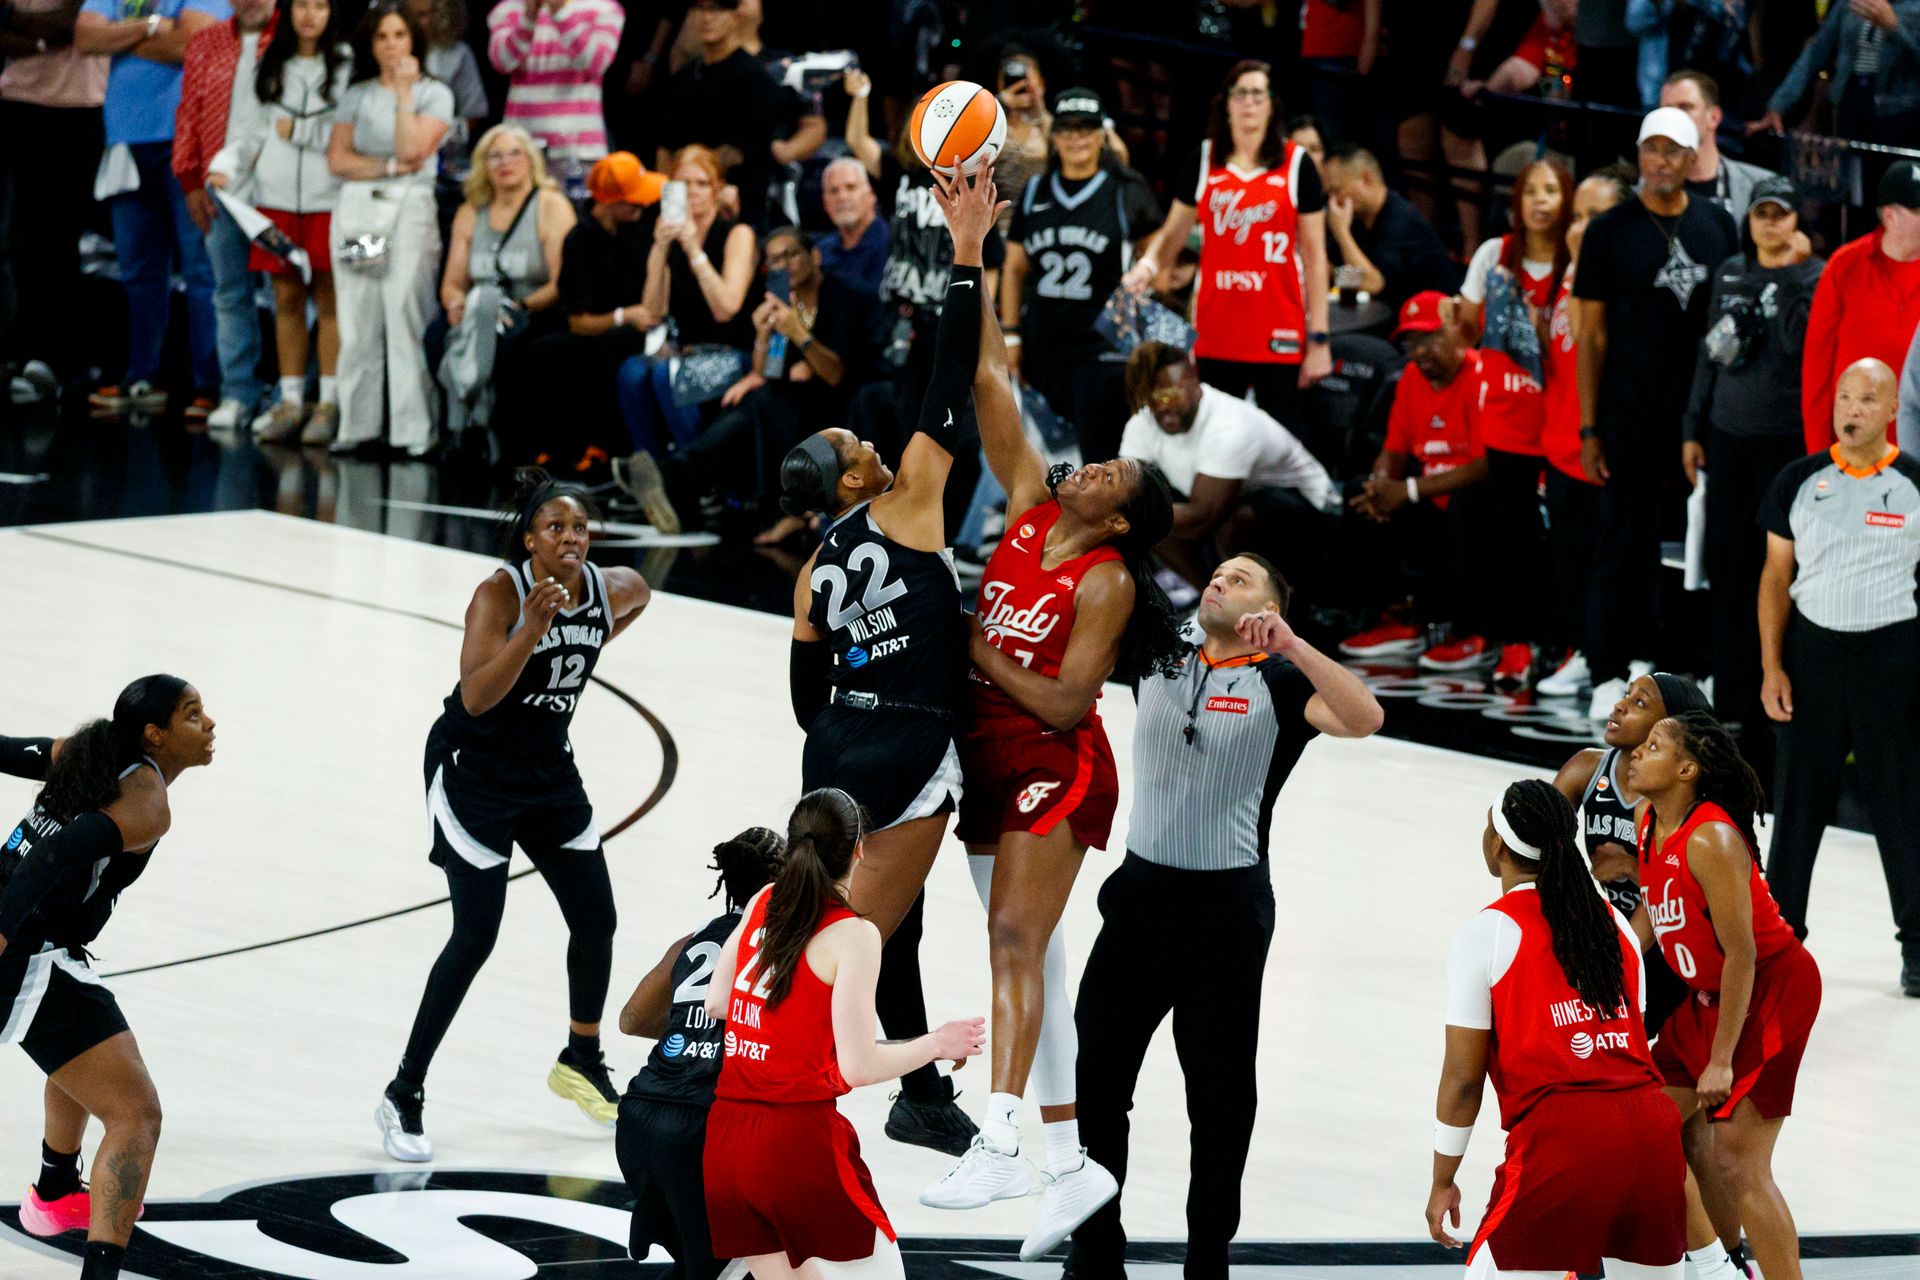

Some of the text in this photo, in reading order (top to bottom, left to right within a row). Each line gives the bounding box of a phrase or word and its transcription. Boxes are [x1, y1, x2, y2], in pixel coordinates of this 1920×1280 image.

[1056, 98, 1100, 114] ACES
[1213, 188, 1279, 245] Vegas
[1261, 231, 1289, 264] 12
[1037, 251, 1093, 300] 22
[1216, 270, 1267, 291] IPSY
[1504, 372, 1543, 393] IPS
[811, 541, 909, 632] 22
[846, 606, 898, 644] WILSON
[977, 580, 1061, 644] Indy
[561, 625, 604, 649] VEGAS
[870, 634, 911, 662] AT&T
[547, 653, 586, 690] 12
[1207, 698, 1248, 712] Emirates
[1586, 814, 1612, 836] LAS
[1640, 878, 1686, 934] Indy
[1674, 942, 1697, 979] 0
[732, 998, 761, 1030] CLARK
[683, 1041, 720, 1059] AT&T
[737, 1039, 770, 1061] AT&T
[1595, 1032, 1629, 1051] AT&T
